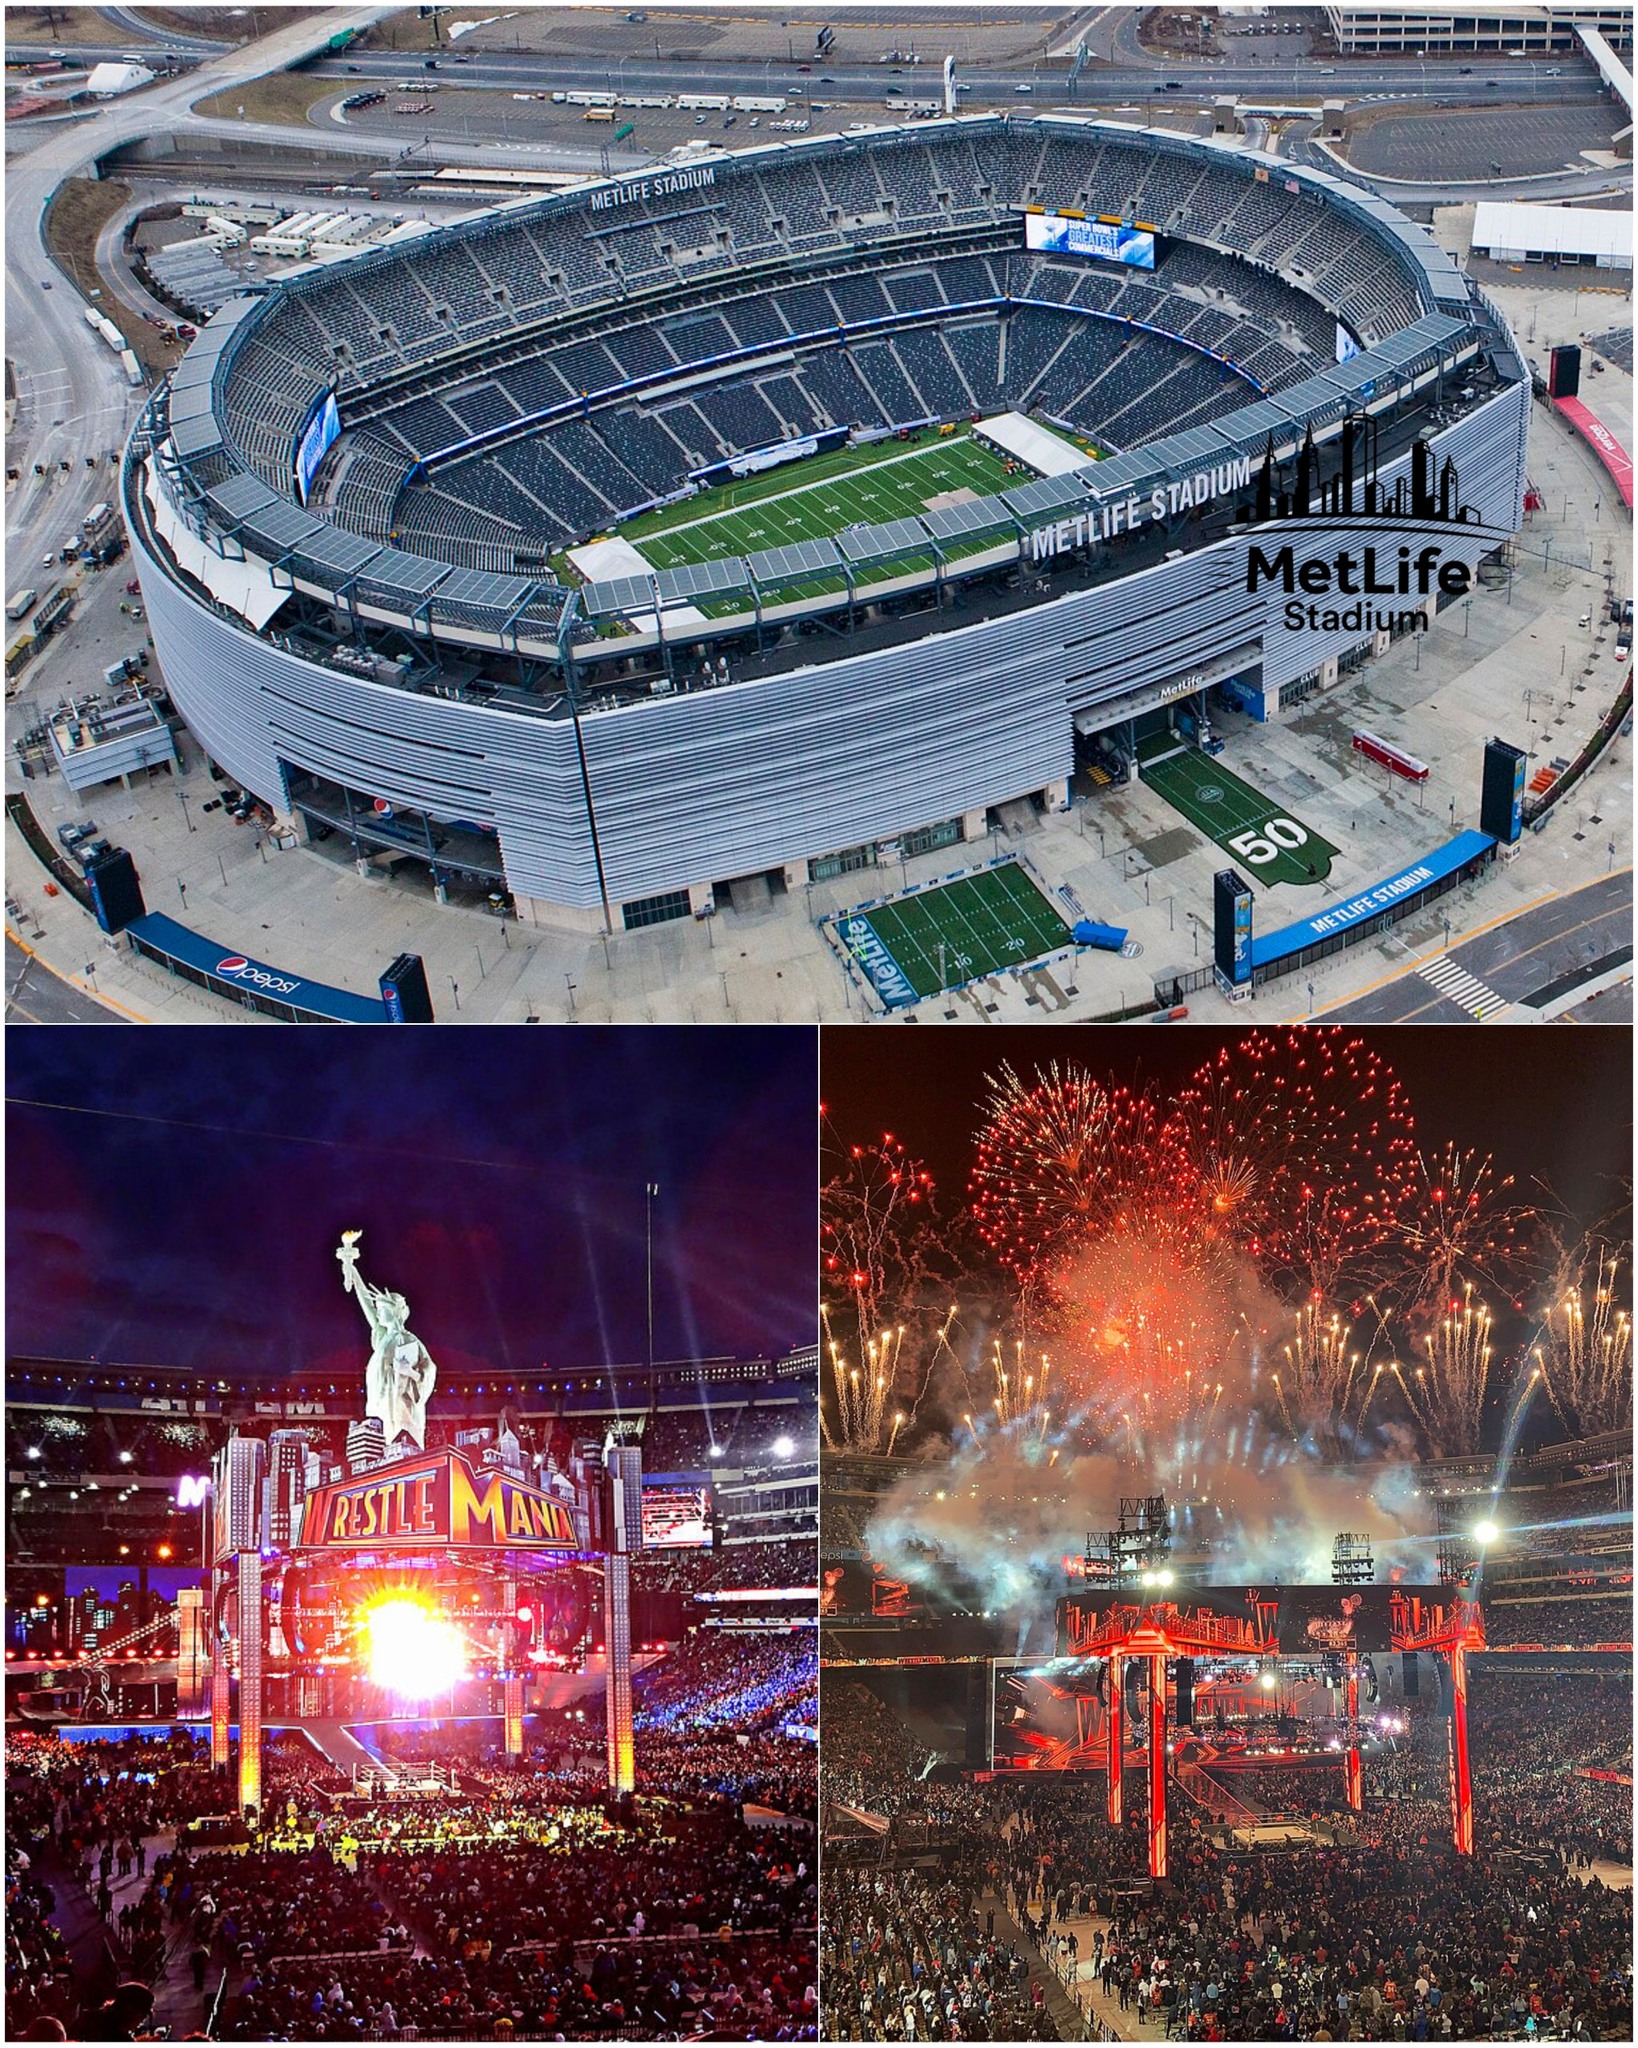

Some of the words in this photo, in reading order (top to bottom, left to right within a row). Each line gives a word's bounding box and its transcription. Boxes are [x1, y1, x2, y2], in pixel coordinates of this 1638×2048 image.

[591, 182, 650, 211] METLIFE
[654, 168, 715, 196] STADIUM
[1068, 220, 1091, 232] SUPER
[1068, 230, 1119, 248] GREATEST
[1032, 496, 1142, 561] METLIFE
[1151, 456, 1250, 521] STADIUM
[1160, 675, 1203, 699] MetLife
[1228, 818, 1309, 865] 50
[1310, 897, 1376, 934] METLIFE
[1372, 866, 1435, 904] STADIUM
[847, 919, 912, 1000] MetLife
[1004, 937, 1026, 951] 20
[235, 966, 301, 994] pepsi
